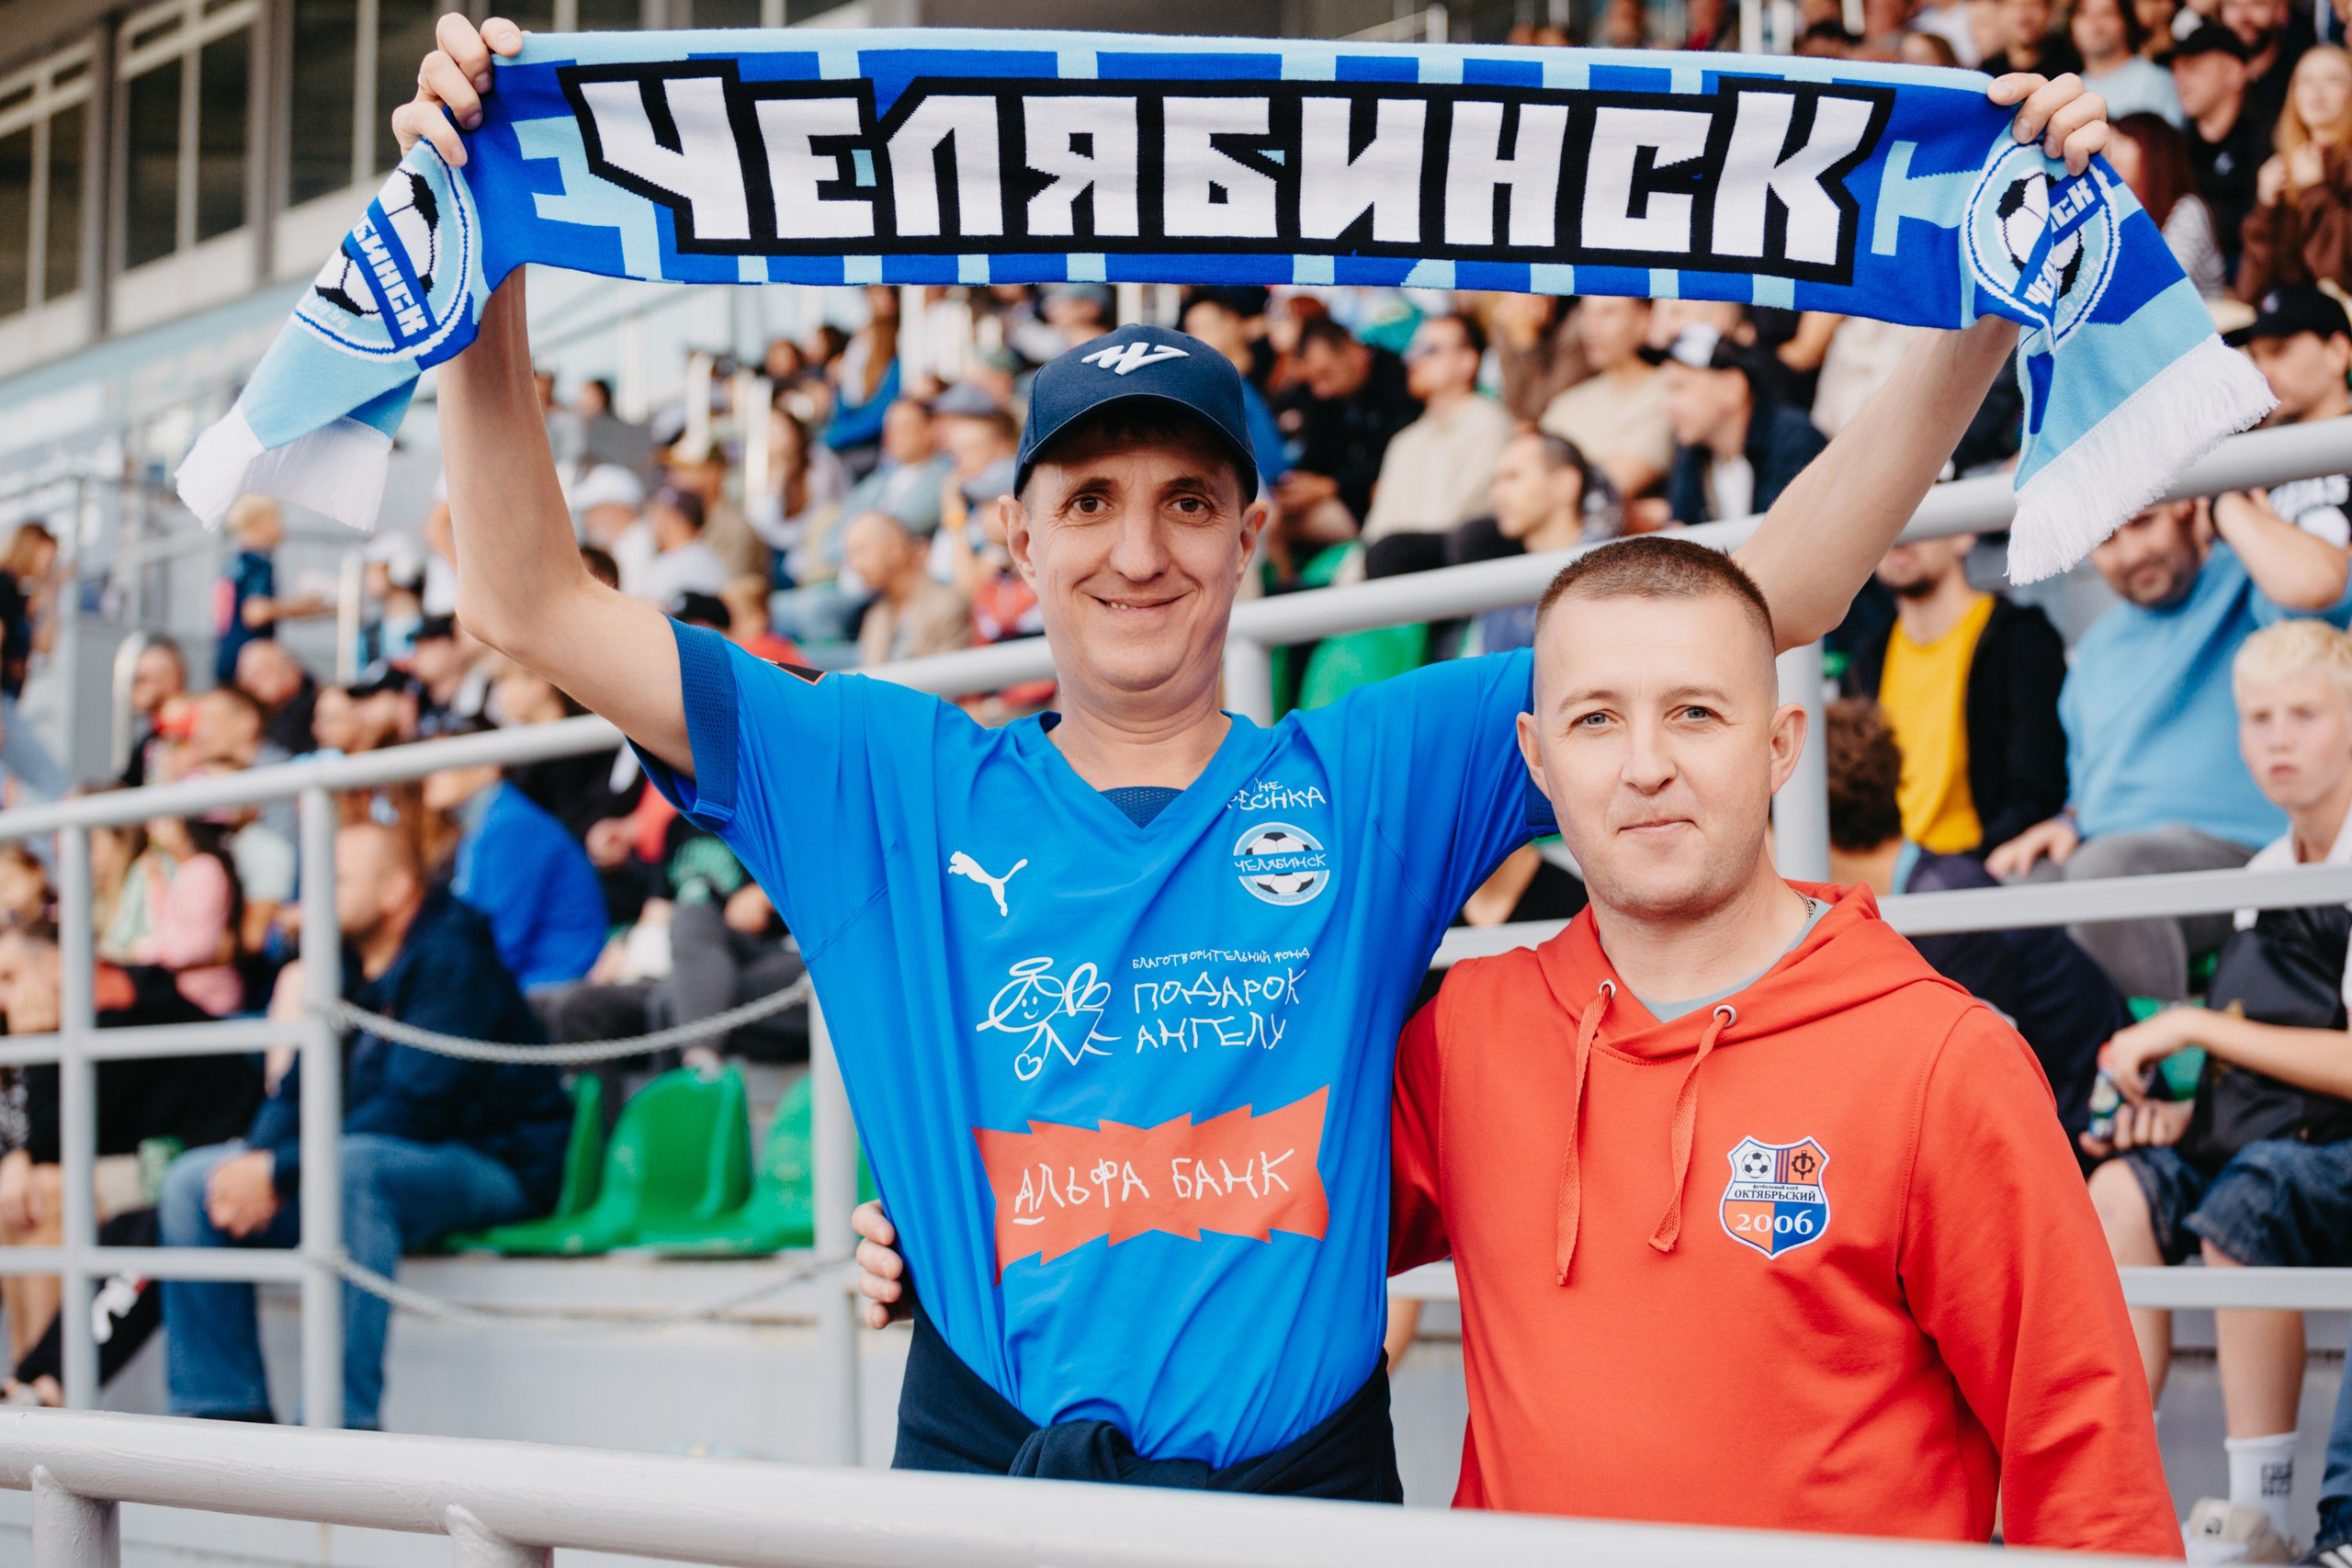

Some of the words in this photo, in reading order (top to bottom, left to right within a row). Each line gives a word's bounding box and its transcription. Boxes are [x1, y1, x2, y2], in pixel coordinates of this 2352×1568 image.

[578, 76, 1875, 266] ЧЕЛЯБИНСК
[352, 216, 429, 337] БИНСК
[1234, 853, 1327, 873] ЧЕЛЯБИНСК
[1273, 947, 1310, 963] ФОНД
[1134, 967, 1306, 1014] ПОДАРОК
[1136, 1011, 1286, 1054] АНГЕЛУ
[1012, 1158, 1149, 1224] АЛЬФА
[1171, 1148, 1295, 1200] БАНК
[1734, 1189, 1816, 1201] ОКТЯБРЬСКИЙ
[1735, 1209, 1814, 1235] 2006
